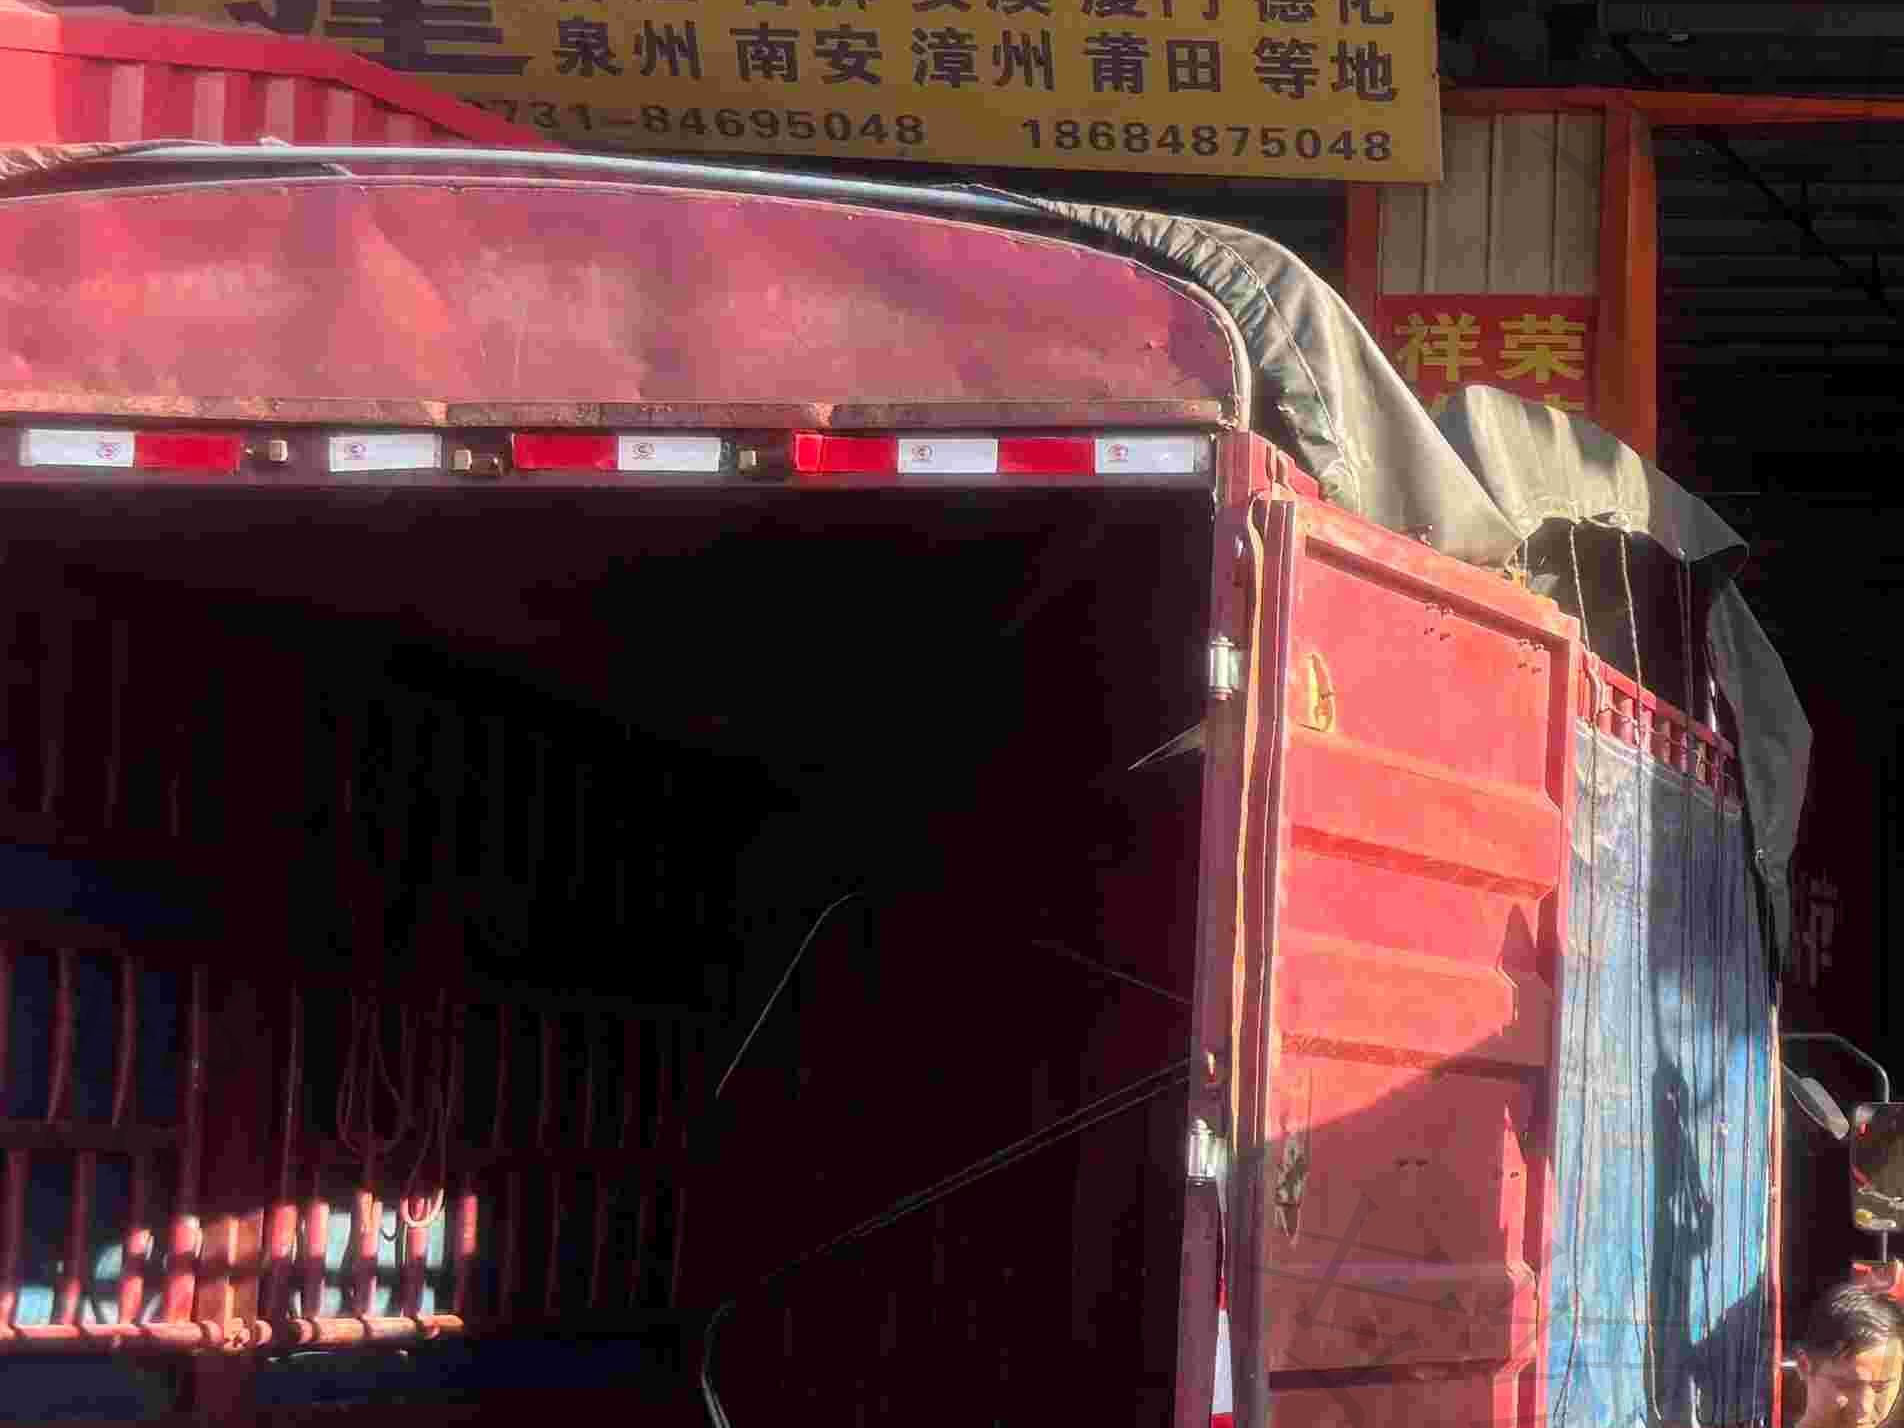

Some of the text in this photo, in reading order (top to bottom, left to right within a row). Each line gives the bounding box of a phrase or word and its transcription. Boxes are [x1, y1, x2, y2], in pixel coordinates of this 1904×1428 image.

[554, 18, 1397, 103] 泉州 南安 漳州 莆田 等地
[457, 96, 1394, 162] 731-84695048 18684875048
[1394, 313, 1585, 384] 祥荣
